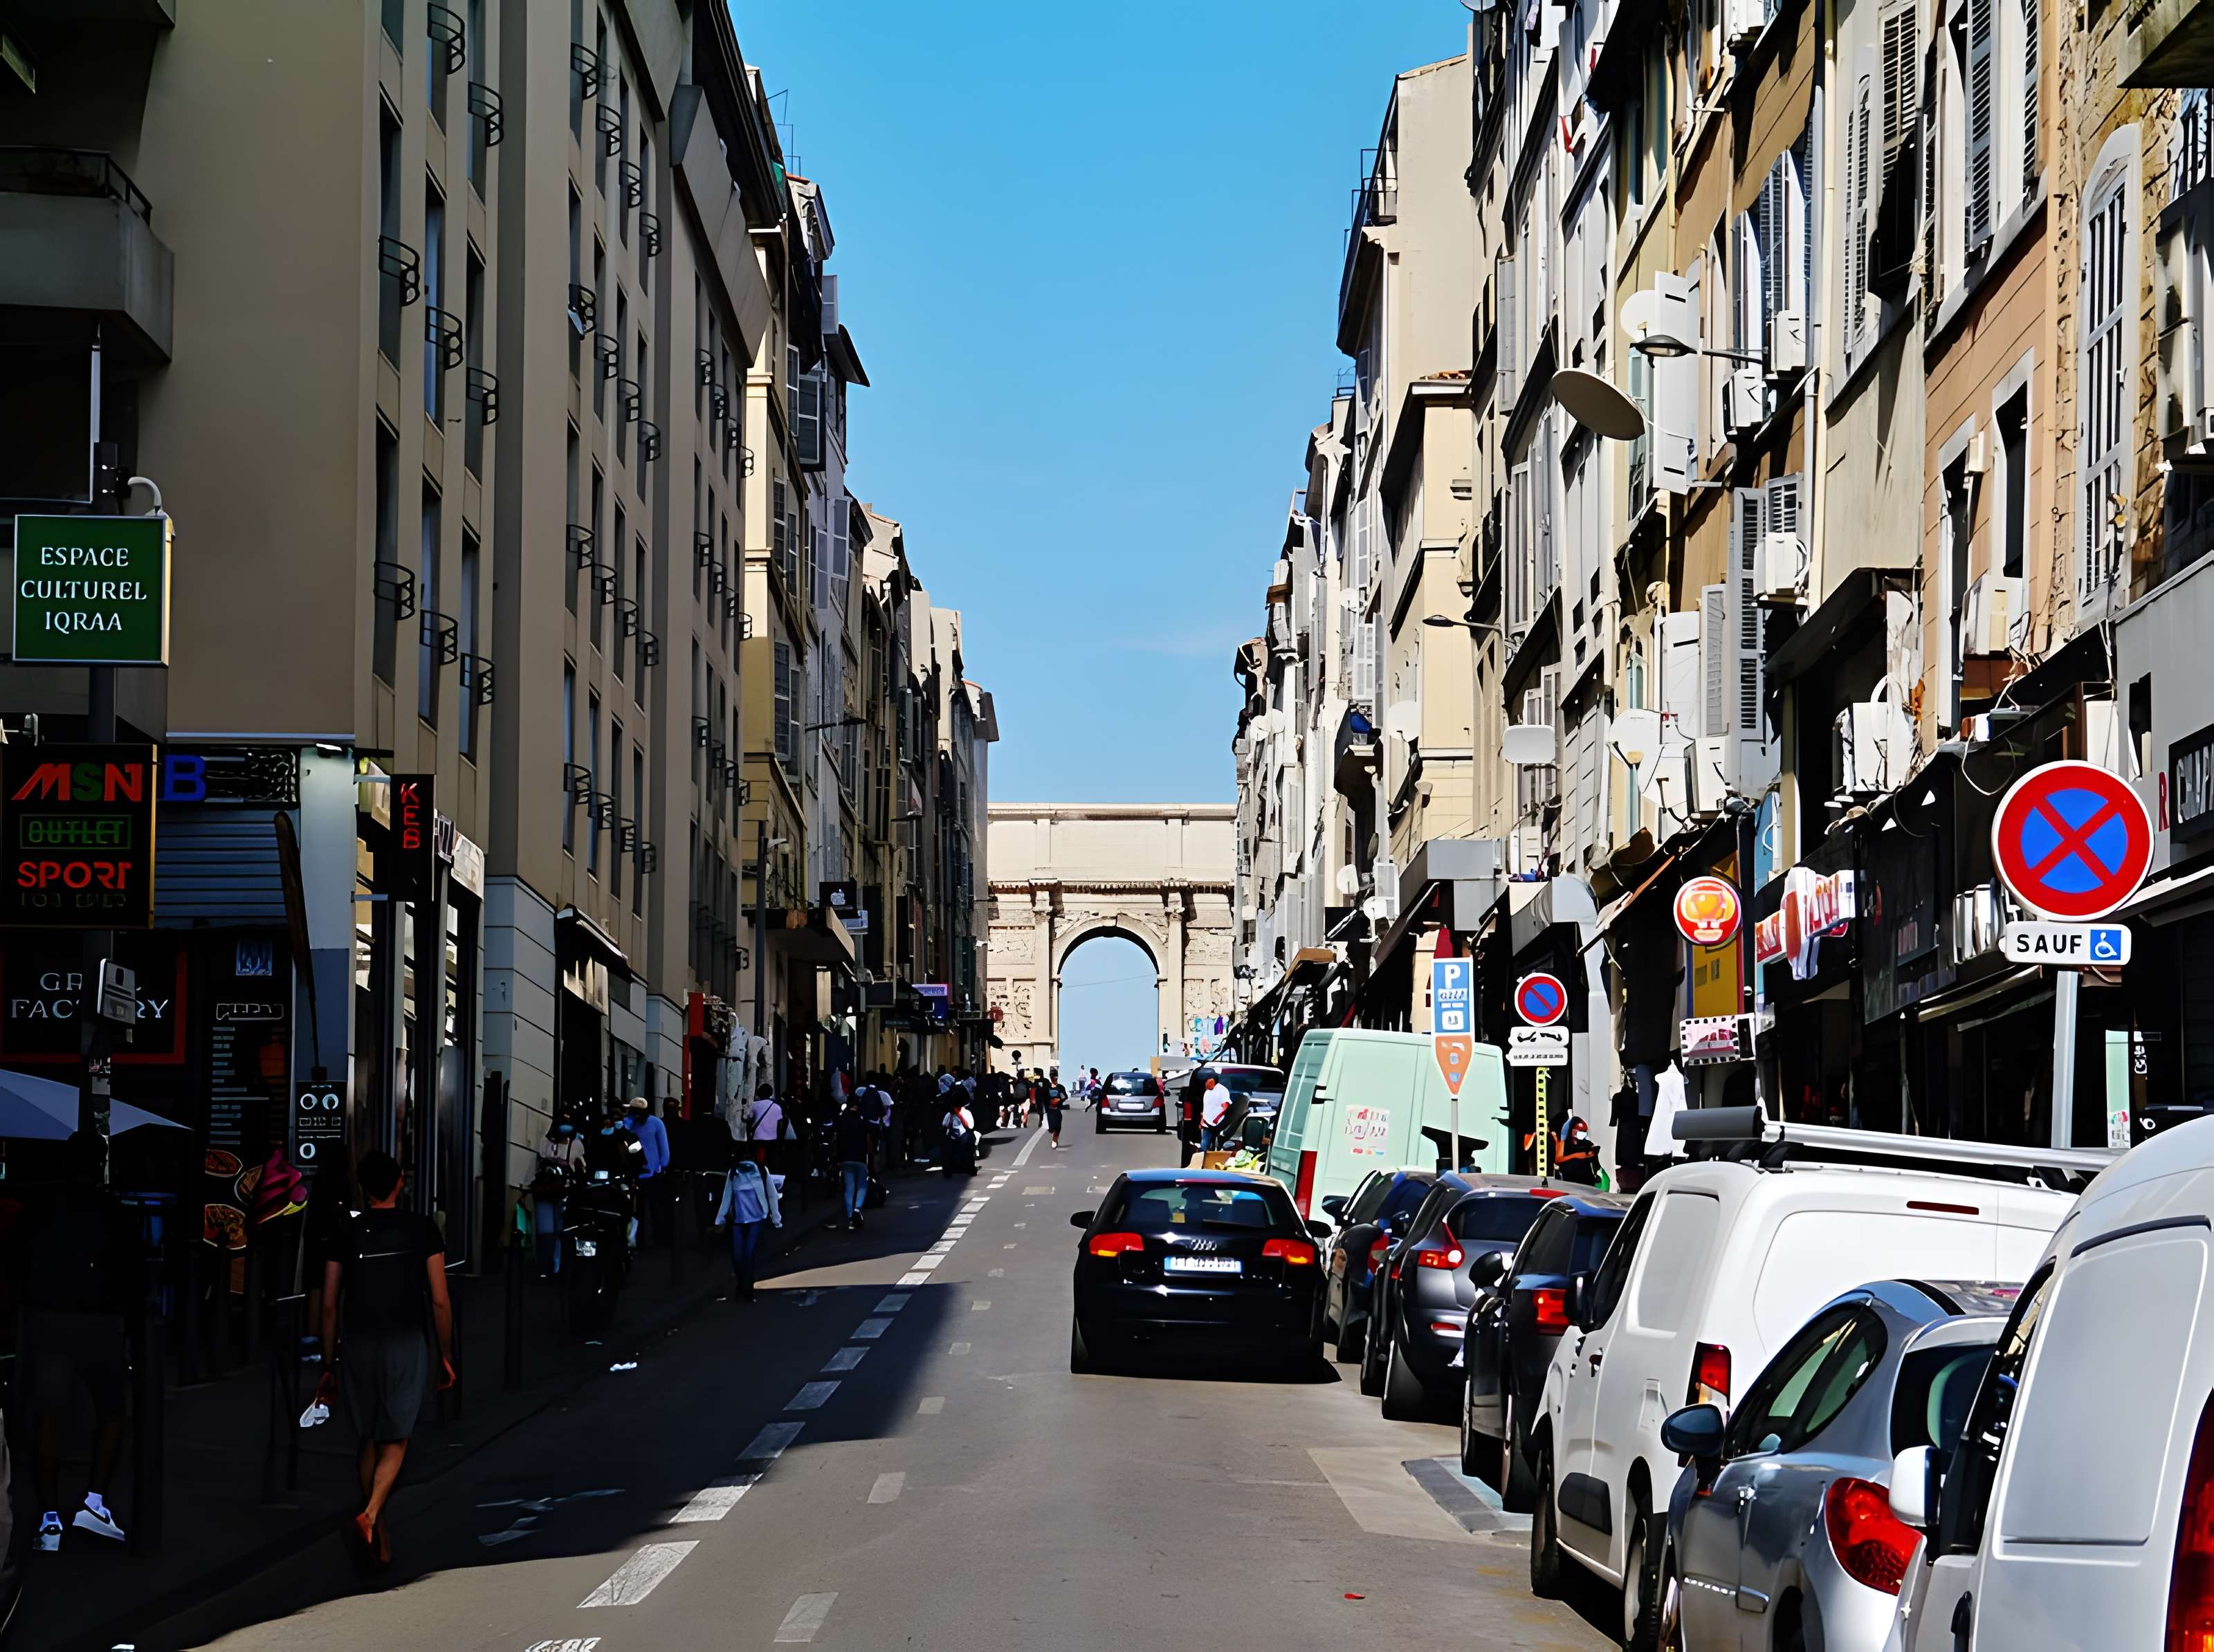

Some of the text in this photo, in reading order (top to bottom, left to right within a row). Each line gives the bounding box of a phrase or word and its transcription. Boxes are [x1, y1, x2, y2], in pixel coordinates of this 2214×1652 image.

[41, 547, 129, 567] ESPACE
[21, 580, 147, 600] CULTUREL
[45, 612, 122, 634] IQRAA
[11, 763, 143, 802] MSN
[28, 820, 125, 844] OUTLET
[17, 861, 132, 890] SPORT
[2017, 933, 2082, 954] SAUF
